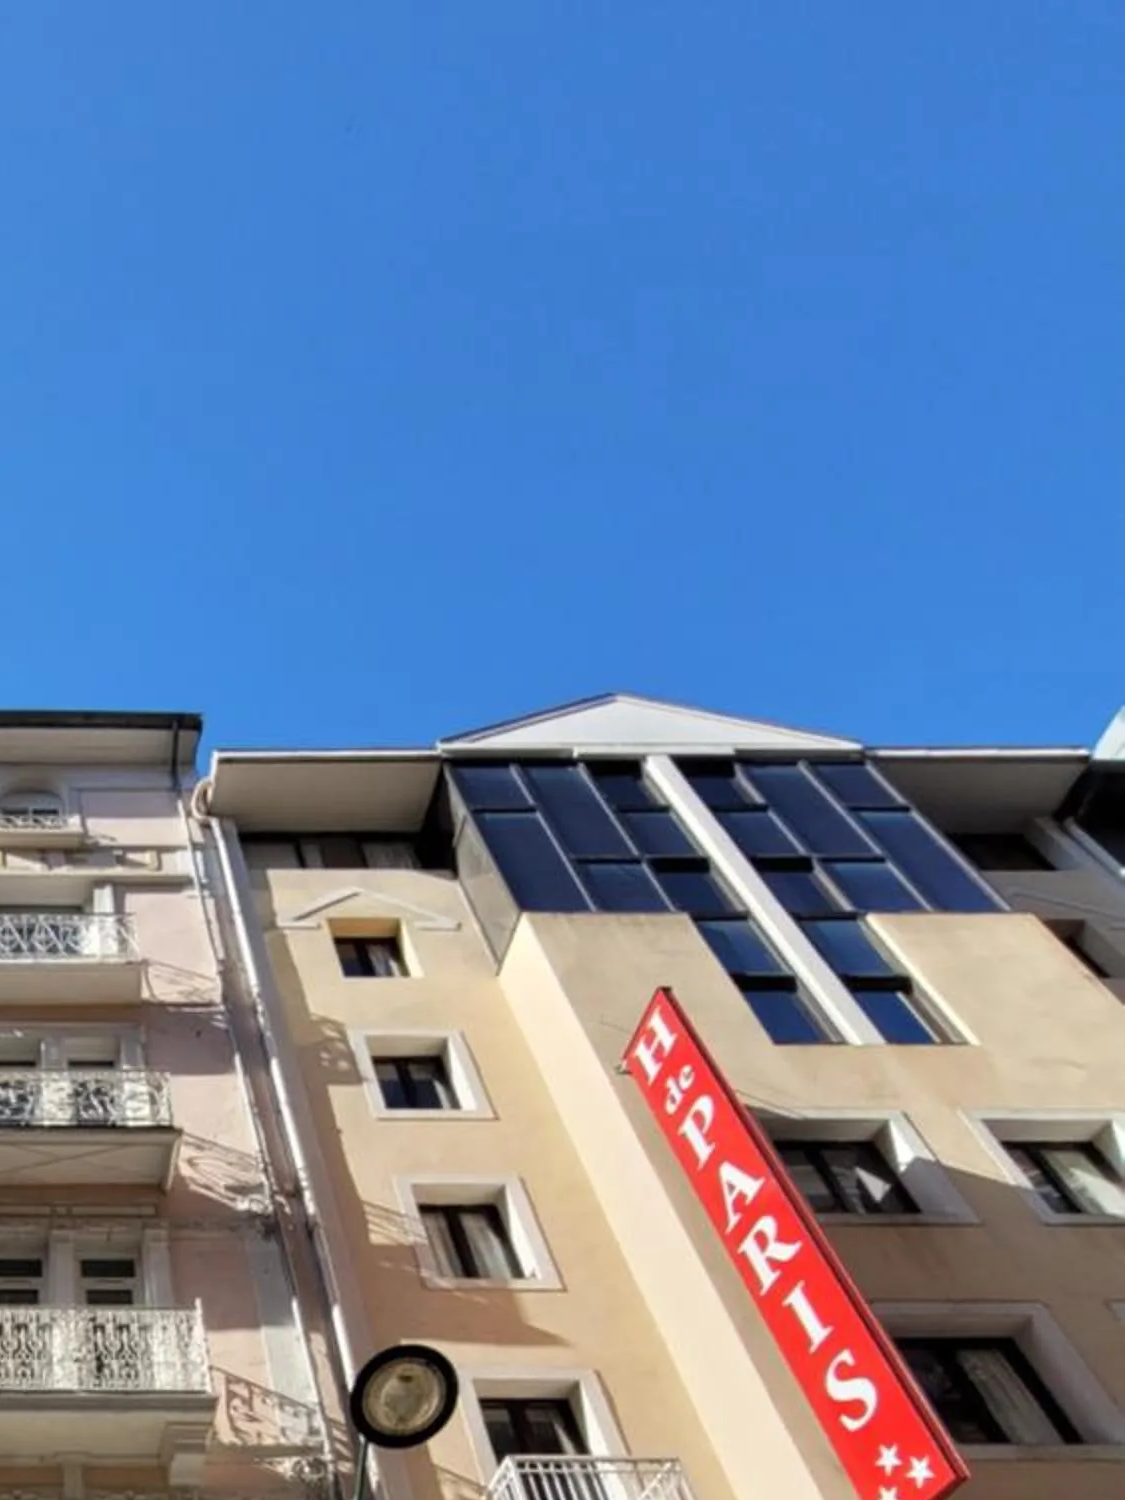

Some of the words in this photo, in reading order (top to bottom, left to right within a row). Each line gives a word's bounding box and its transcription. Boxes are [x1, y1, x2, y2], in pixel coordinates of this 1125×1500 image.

[633, 1006, 678, 1085] H
[663, 1062, 696, 1115] de
[678, 1092, 879, 1433] PARIS
